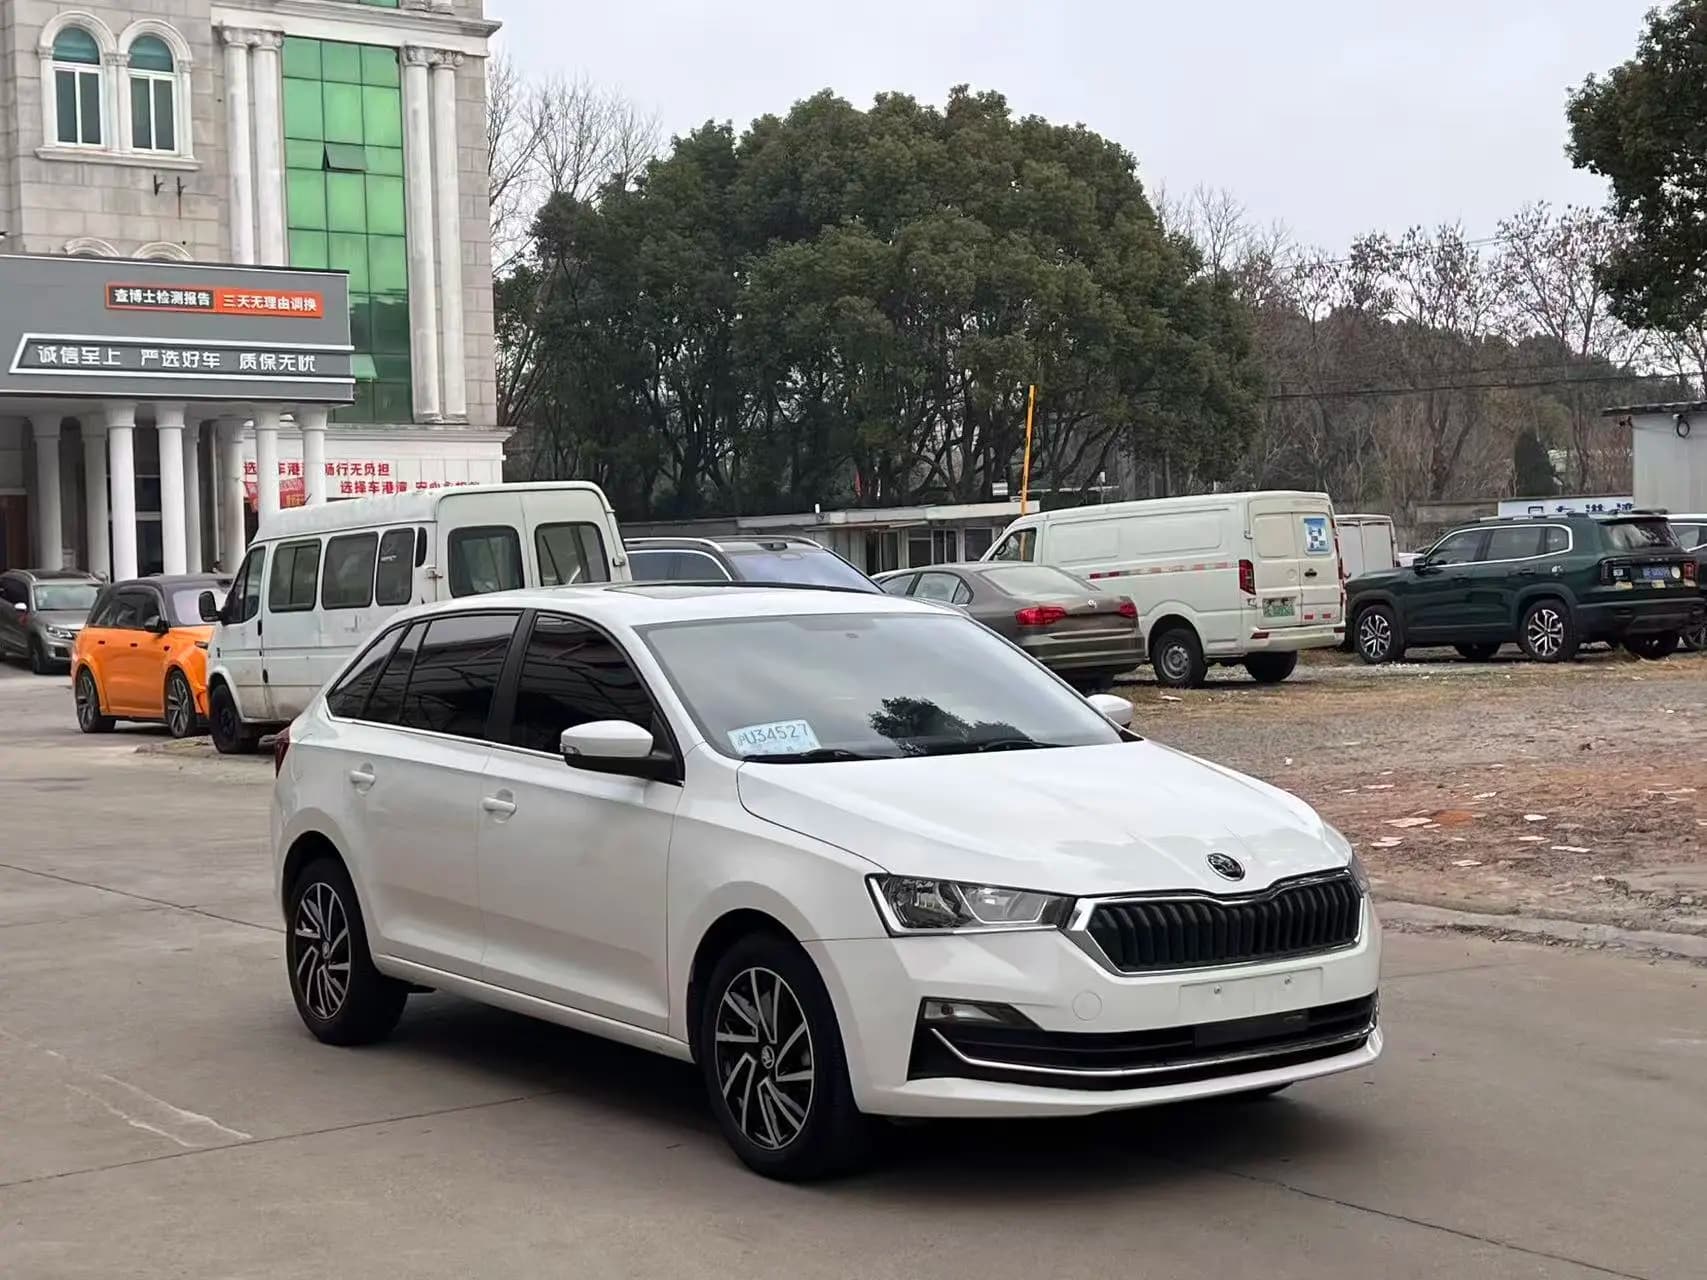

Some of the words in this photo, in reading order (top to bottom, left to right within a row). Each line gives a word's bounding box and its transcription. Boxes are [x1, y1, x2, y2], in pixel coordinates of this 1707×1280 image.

[114, 288, 211, 306] 查博士检测报告
[223, 294, 317, 312] 三天无理由调换
[37, 345, 121, 366] 诚信至上
[140, 350, 221, 369] 严选好车
[239, 352, 316, 372] 质保无忧
